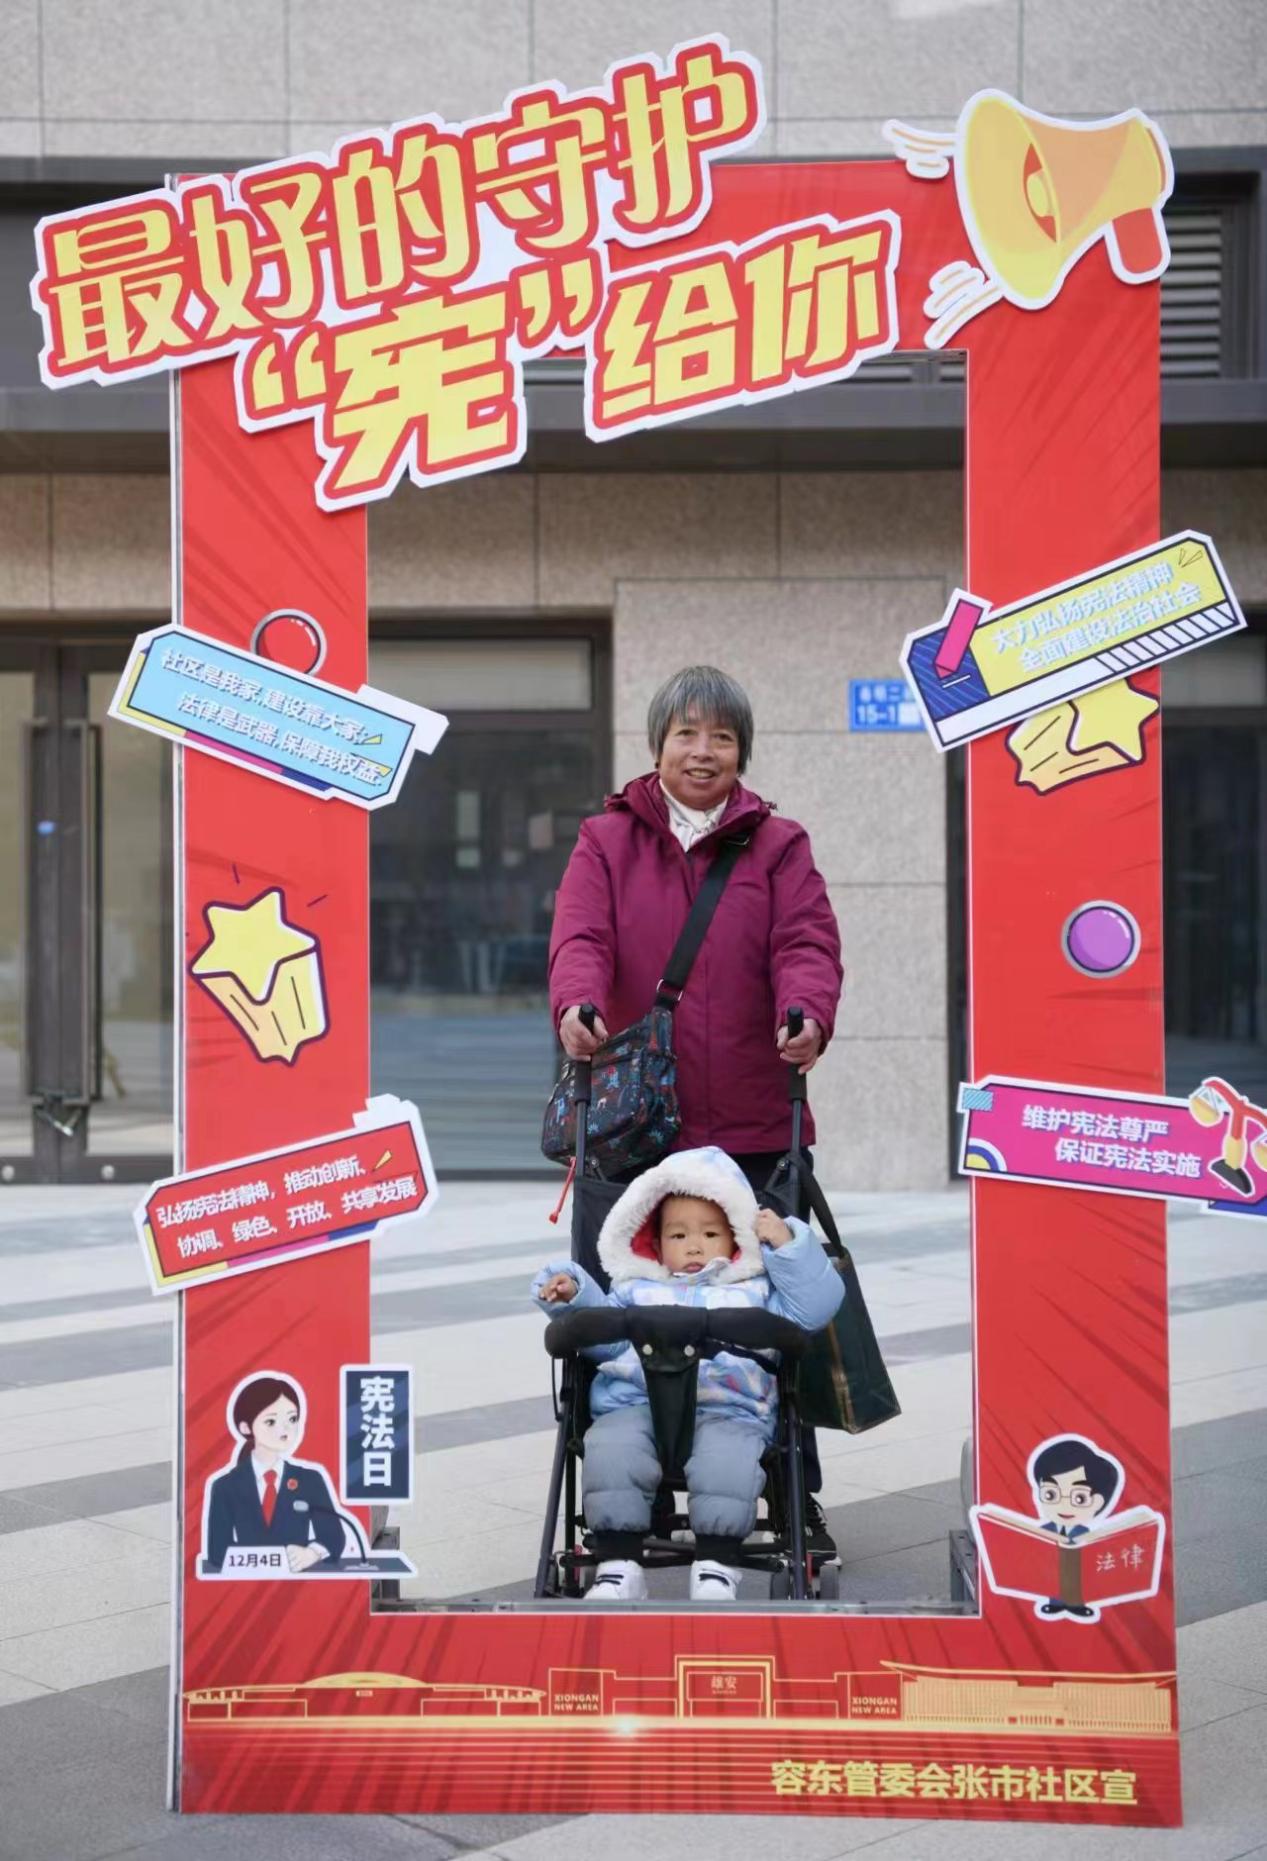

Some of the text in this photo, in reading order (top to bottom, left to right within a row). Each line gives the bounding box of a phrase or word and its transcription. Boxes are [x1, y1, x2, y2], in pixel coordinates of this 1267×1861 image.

[49, 54, 749, 367] 最好的守护
[993, 562, 1174, 653] 大力弘扬宪法精神
[1021, 581, 1202, 672] 全面建设法治社会
[1022, 1104, 1169, 1142] 维护宪法尊严
[1054, 1137, 1202, 1179] 保证宪法实施
[360, 1376, 395, 1487] 宪法日
[228, 1552, 281, 1567] 12月4日
[1096, 1544, 1144, 1573] 法律
[554, 1694, 599, 1702] XIONGAN
[554, 1703, 598, 1711] NEW AREA
[852, 1697, 897, 1705] XIONGAN
[852, 1706, 896, 1714] NEW AREA
[771, 1759, 1138, 1806] 容东管委会张市社区宣
